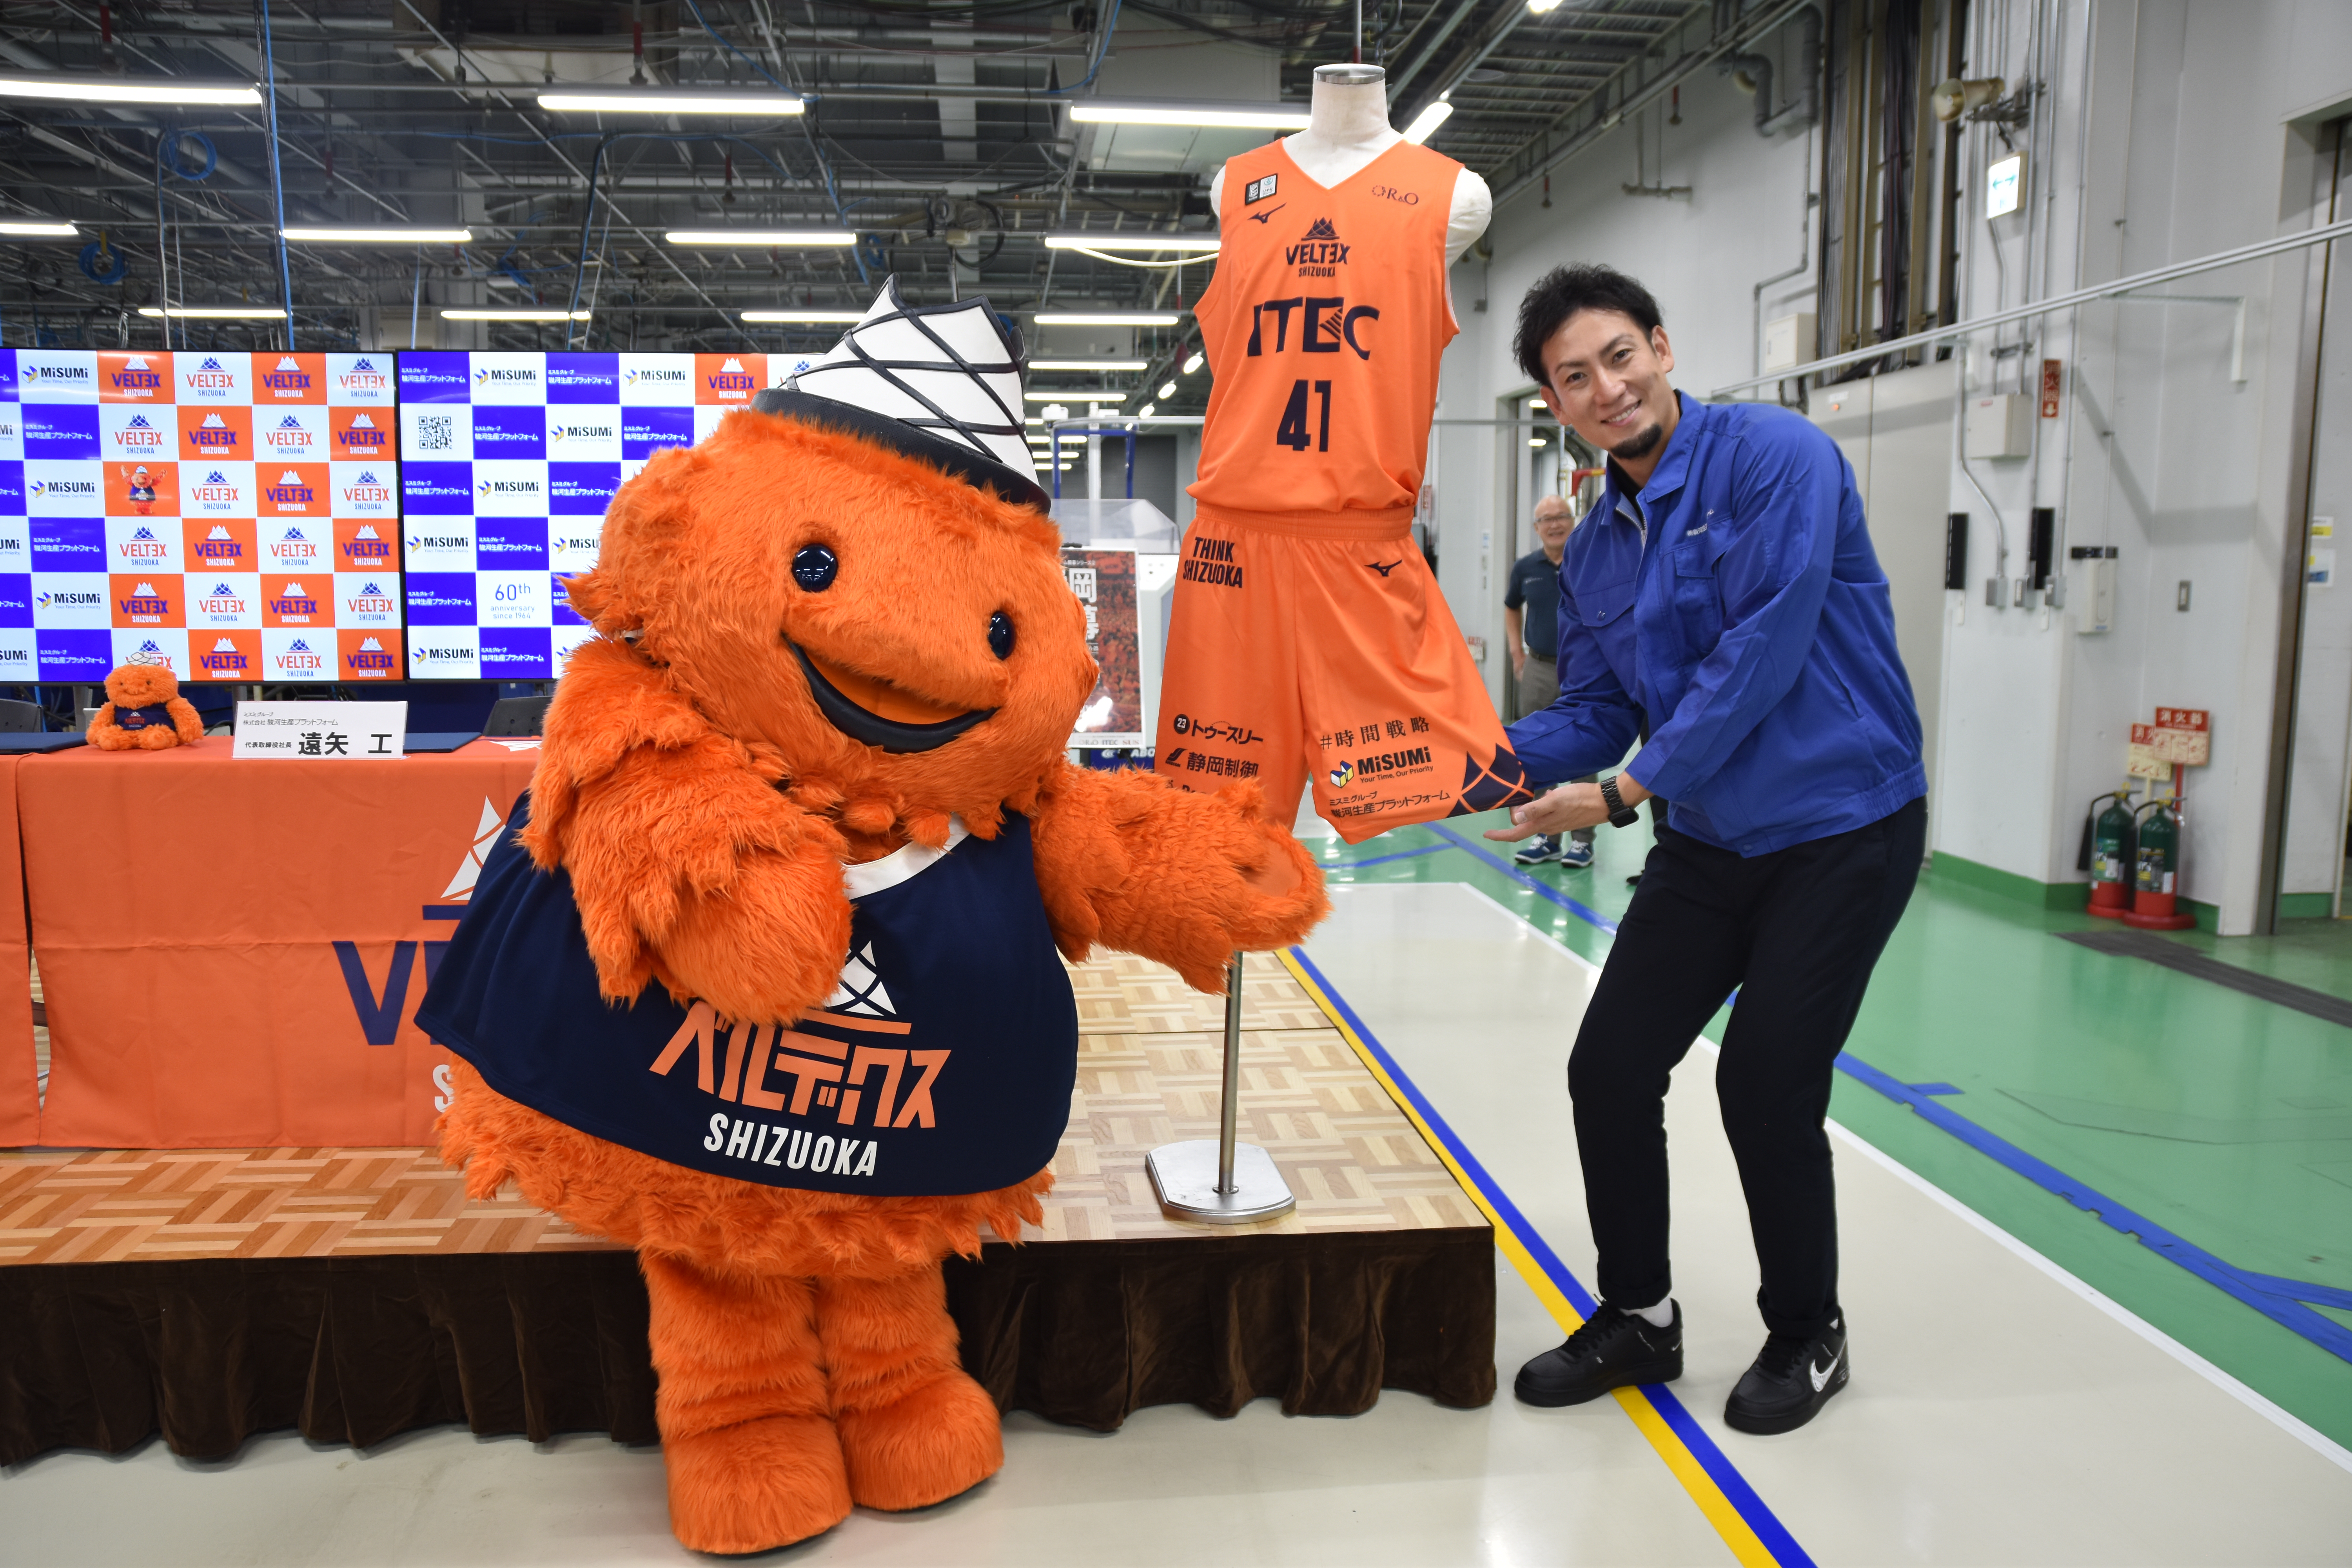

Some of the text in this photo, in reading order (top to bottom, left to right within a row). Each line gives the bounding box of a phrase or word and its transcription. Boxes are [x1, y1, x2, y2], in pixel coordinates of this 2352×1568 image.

[1286, 243, 1351, 265] VELTEX
[1299, 266, 1336, 277] SHIZUOKA
[1247, 297, 1380, 361] ITEC
[41, 367, 88, 378] MiSUMi
[492, 369, 536, 380] MiSUMi
[641, 370, 686, 380] MiSUMi
[112, 373, 161, 387] VELTEX
[186, 374, 234, 387] VELTEX
[263, 374, 310, 388] VELTEX
[339, 375, 385, 388] VELTEX
[548, 376, 612, 385] 駿河生産プラットフォーム
[708, 376, 754, 389] VELTEX
[1276, 379, 1332, 452] 41
[568, 426, 612, 436] MiSUMi
[114, 432, 163, 445] VELTEX
[189, 431, 236, 445] VELTEX
[266, 432, 312, 445] VELTEX
[338, 431, 385, 445] VELTEX
[48, 482, 95, 492] MiSUMi
[495, 481, 539, 492] MiSUMi
[192, 488, 239, 501] VELTEX
[266, 488, 314, 502] VELTEX
[343, 488, 389, 501] VELTEX
[424, 537, 468, 547] MiSUMi
[119, 544, 167, 557] VELTEX
[194, 543, 242, 557] VELTEX
[270, 544, 317, 557] VELTEX
[343, 543, 390, 556] VELTEX
[1193, 536, 1235, 563] THINK
[1183, 559, 1243, 588] SHIZUOKA
[54, 593, 101, 604] MiSUMi
[495, 583, 530, 601] 60th
[120, 600, 168, 614] VELTEX
[198, 600, 245, 613] VELTEX
[270, 600, 317, 614] VELTEX
[348, 599, 394, 612] VELTEX
[430, 648, 473, 659] MiSUMi
[200, 655, 248, 669] VELTEX
[276, 655, 321, 668] VELTEX
[347, 654, 394, 668] VELTEX
[1177, 717, 1263, 744] 23 トゥースリー
[298, 731, 348, 755] 遠矢
[368, 734, 392, 753] 工
[1187, 752, 1259, 778] 静岡制御
[1357, 746, 1432, 775] MiSUMi
[1360, 775, 1375, 783] Your
[1376, 773, 1395, 781] Time,
[1410, 765, 1434, 775] Priority
[1329, 791, 1378, 806] ミスミグループ
[1331, 790, 1450, 818] 駿河生産プラットフォーム
[704, 1113, 878, 1176] SHIZUOKA
